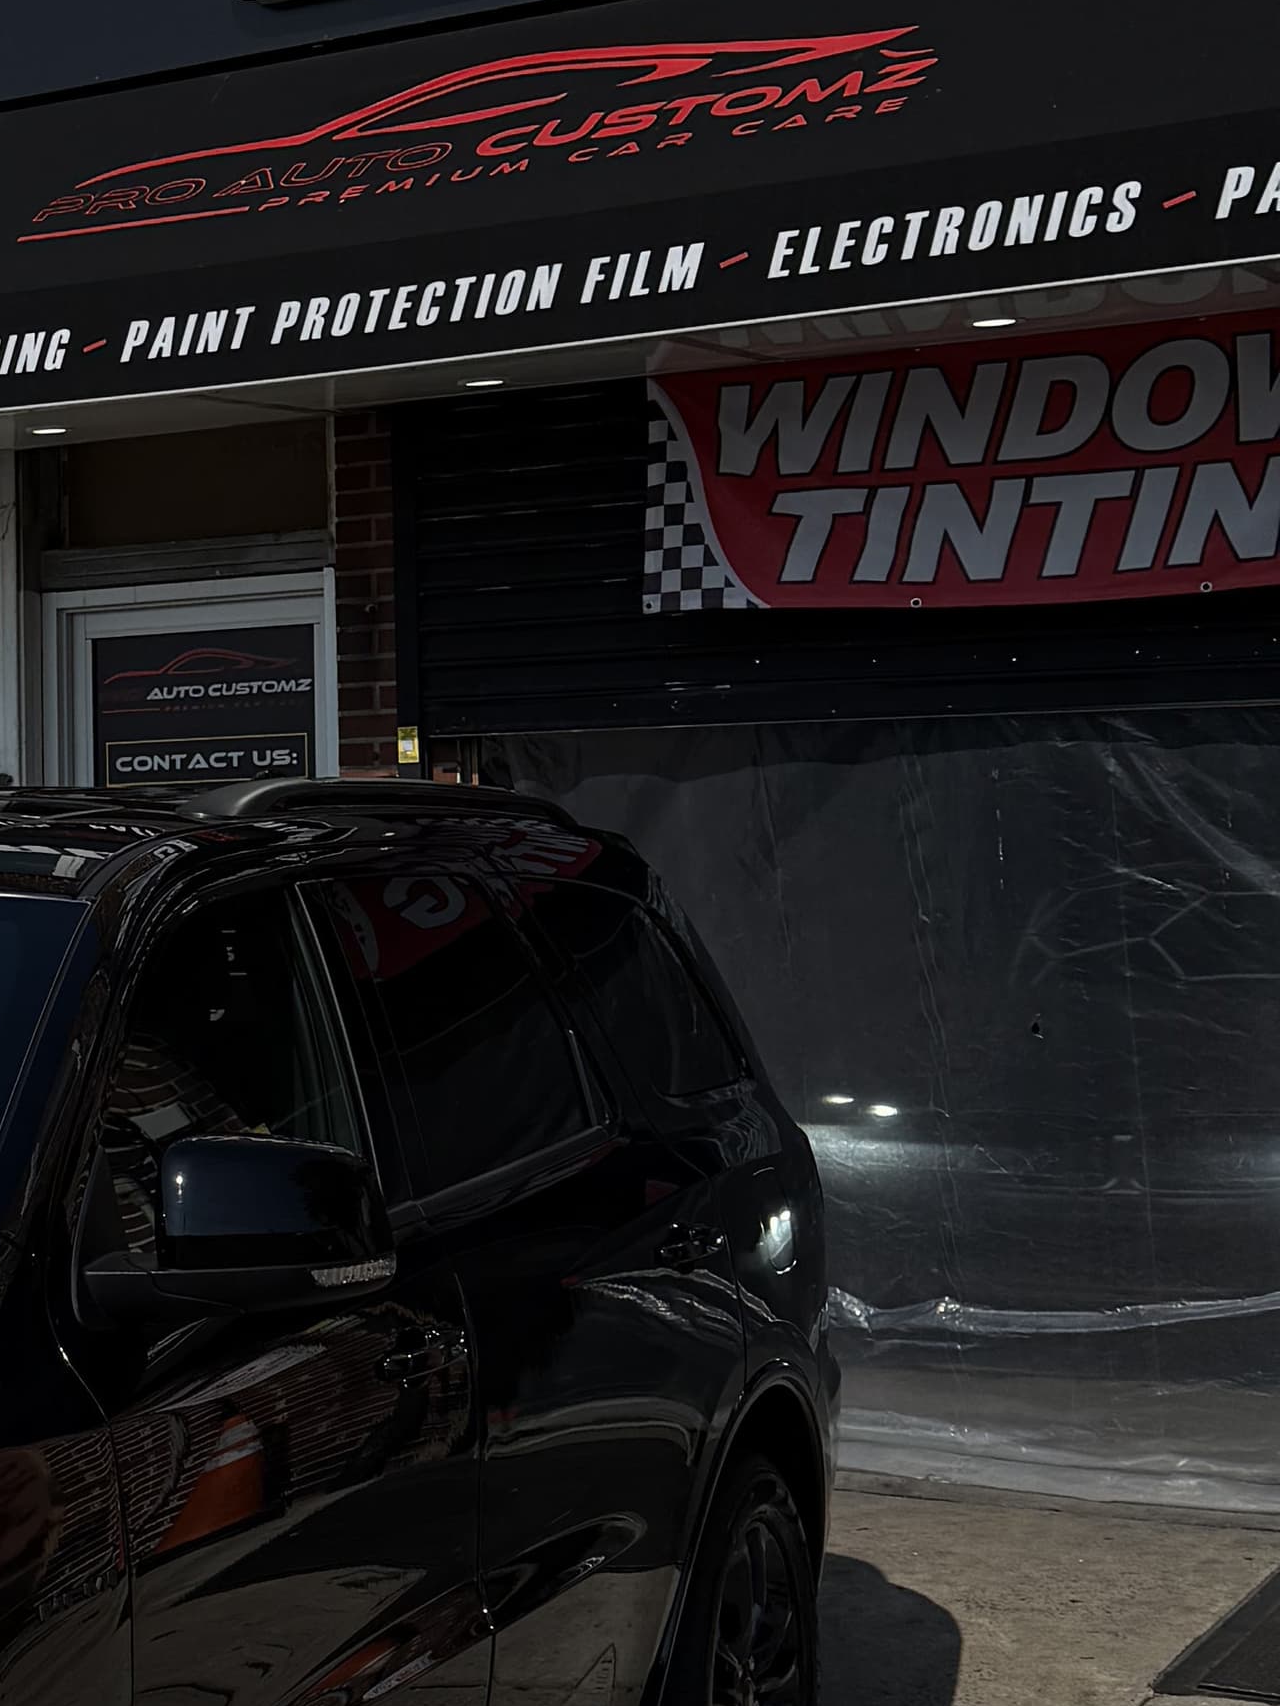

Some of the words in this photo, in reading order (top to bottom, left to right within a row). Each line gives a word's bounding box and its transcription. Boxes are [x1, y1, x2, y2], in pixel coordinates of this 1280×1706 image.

[33, 174, 206, 223] PRO
[214, 142, 454, 194] AUTO
[474, 56, 938, 157] CUSTOMZ
[258, 158, 531, 212] PREMIUM
[568, 131, 688, 163] CAR
[731, 97, 906, 136] CARE
[119, 306, 256, 362] PAINT
[270, 263, 563, 345] PROTECTION
[580, 242, 705, 304] FILM
[767, 180, 1142, 279] ELECTRONICS
[146, 685, 205, 701] AUTO
[208, 677, 313, 697] CUSTOMZ
[115, 750, 245, 773] CONTACT
[252, 749, 299, 767] US:
